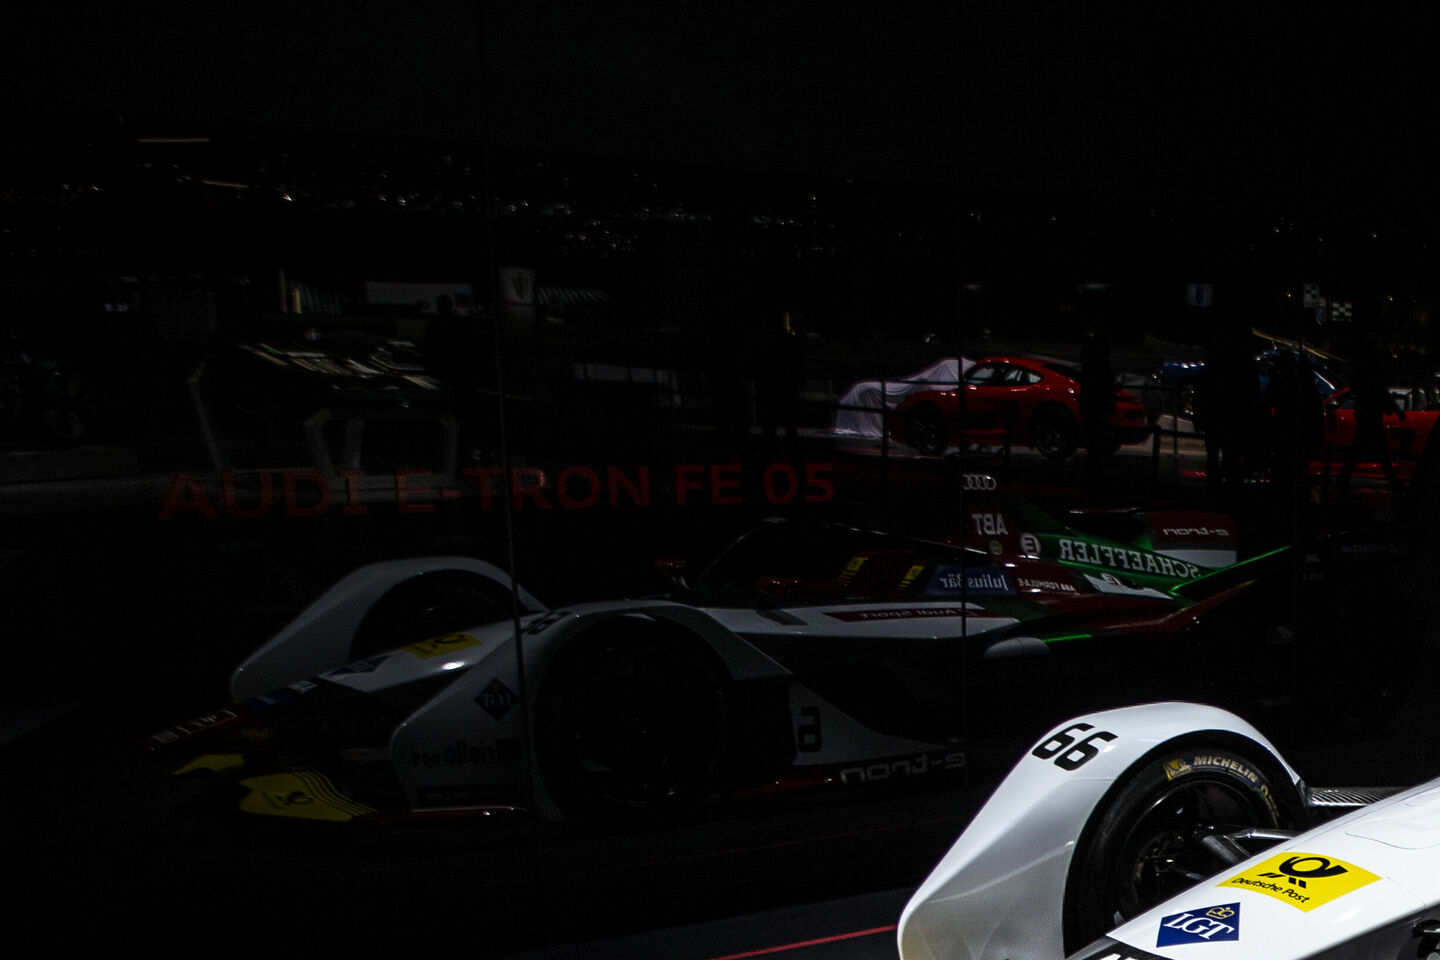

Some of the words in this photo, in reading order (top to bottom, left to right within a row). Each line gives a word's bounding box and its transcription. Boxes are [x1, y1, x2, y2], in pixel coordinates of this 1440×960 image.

[157, 470, 369, 520] AUDI
[394, 465, 652, 516] E-TRON
[675, 462, 745, 507] FE
[763, 462, 837, 504] 05
[1031, 723, 1119, 772] 66
[1194, 755, 1259, 783] MICHELIN
[1231, 878, 1283, 893] Deutsche
[1281, 888, 1310, 904] Post
[1163, 913, 1234, 940] LGT
